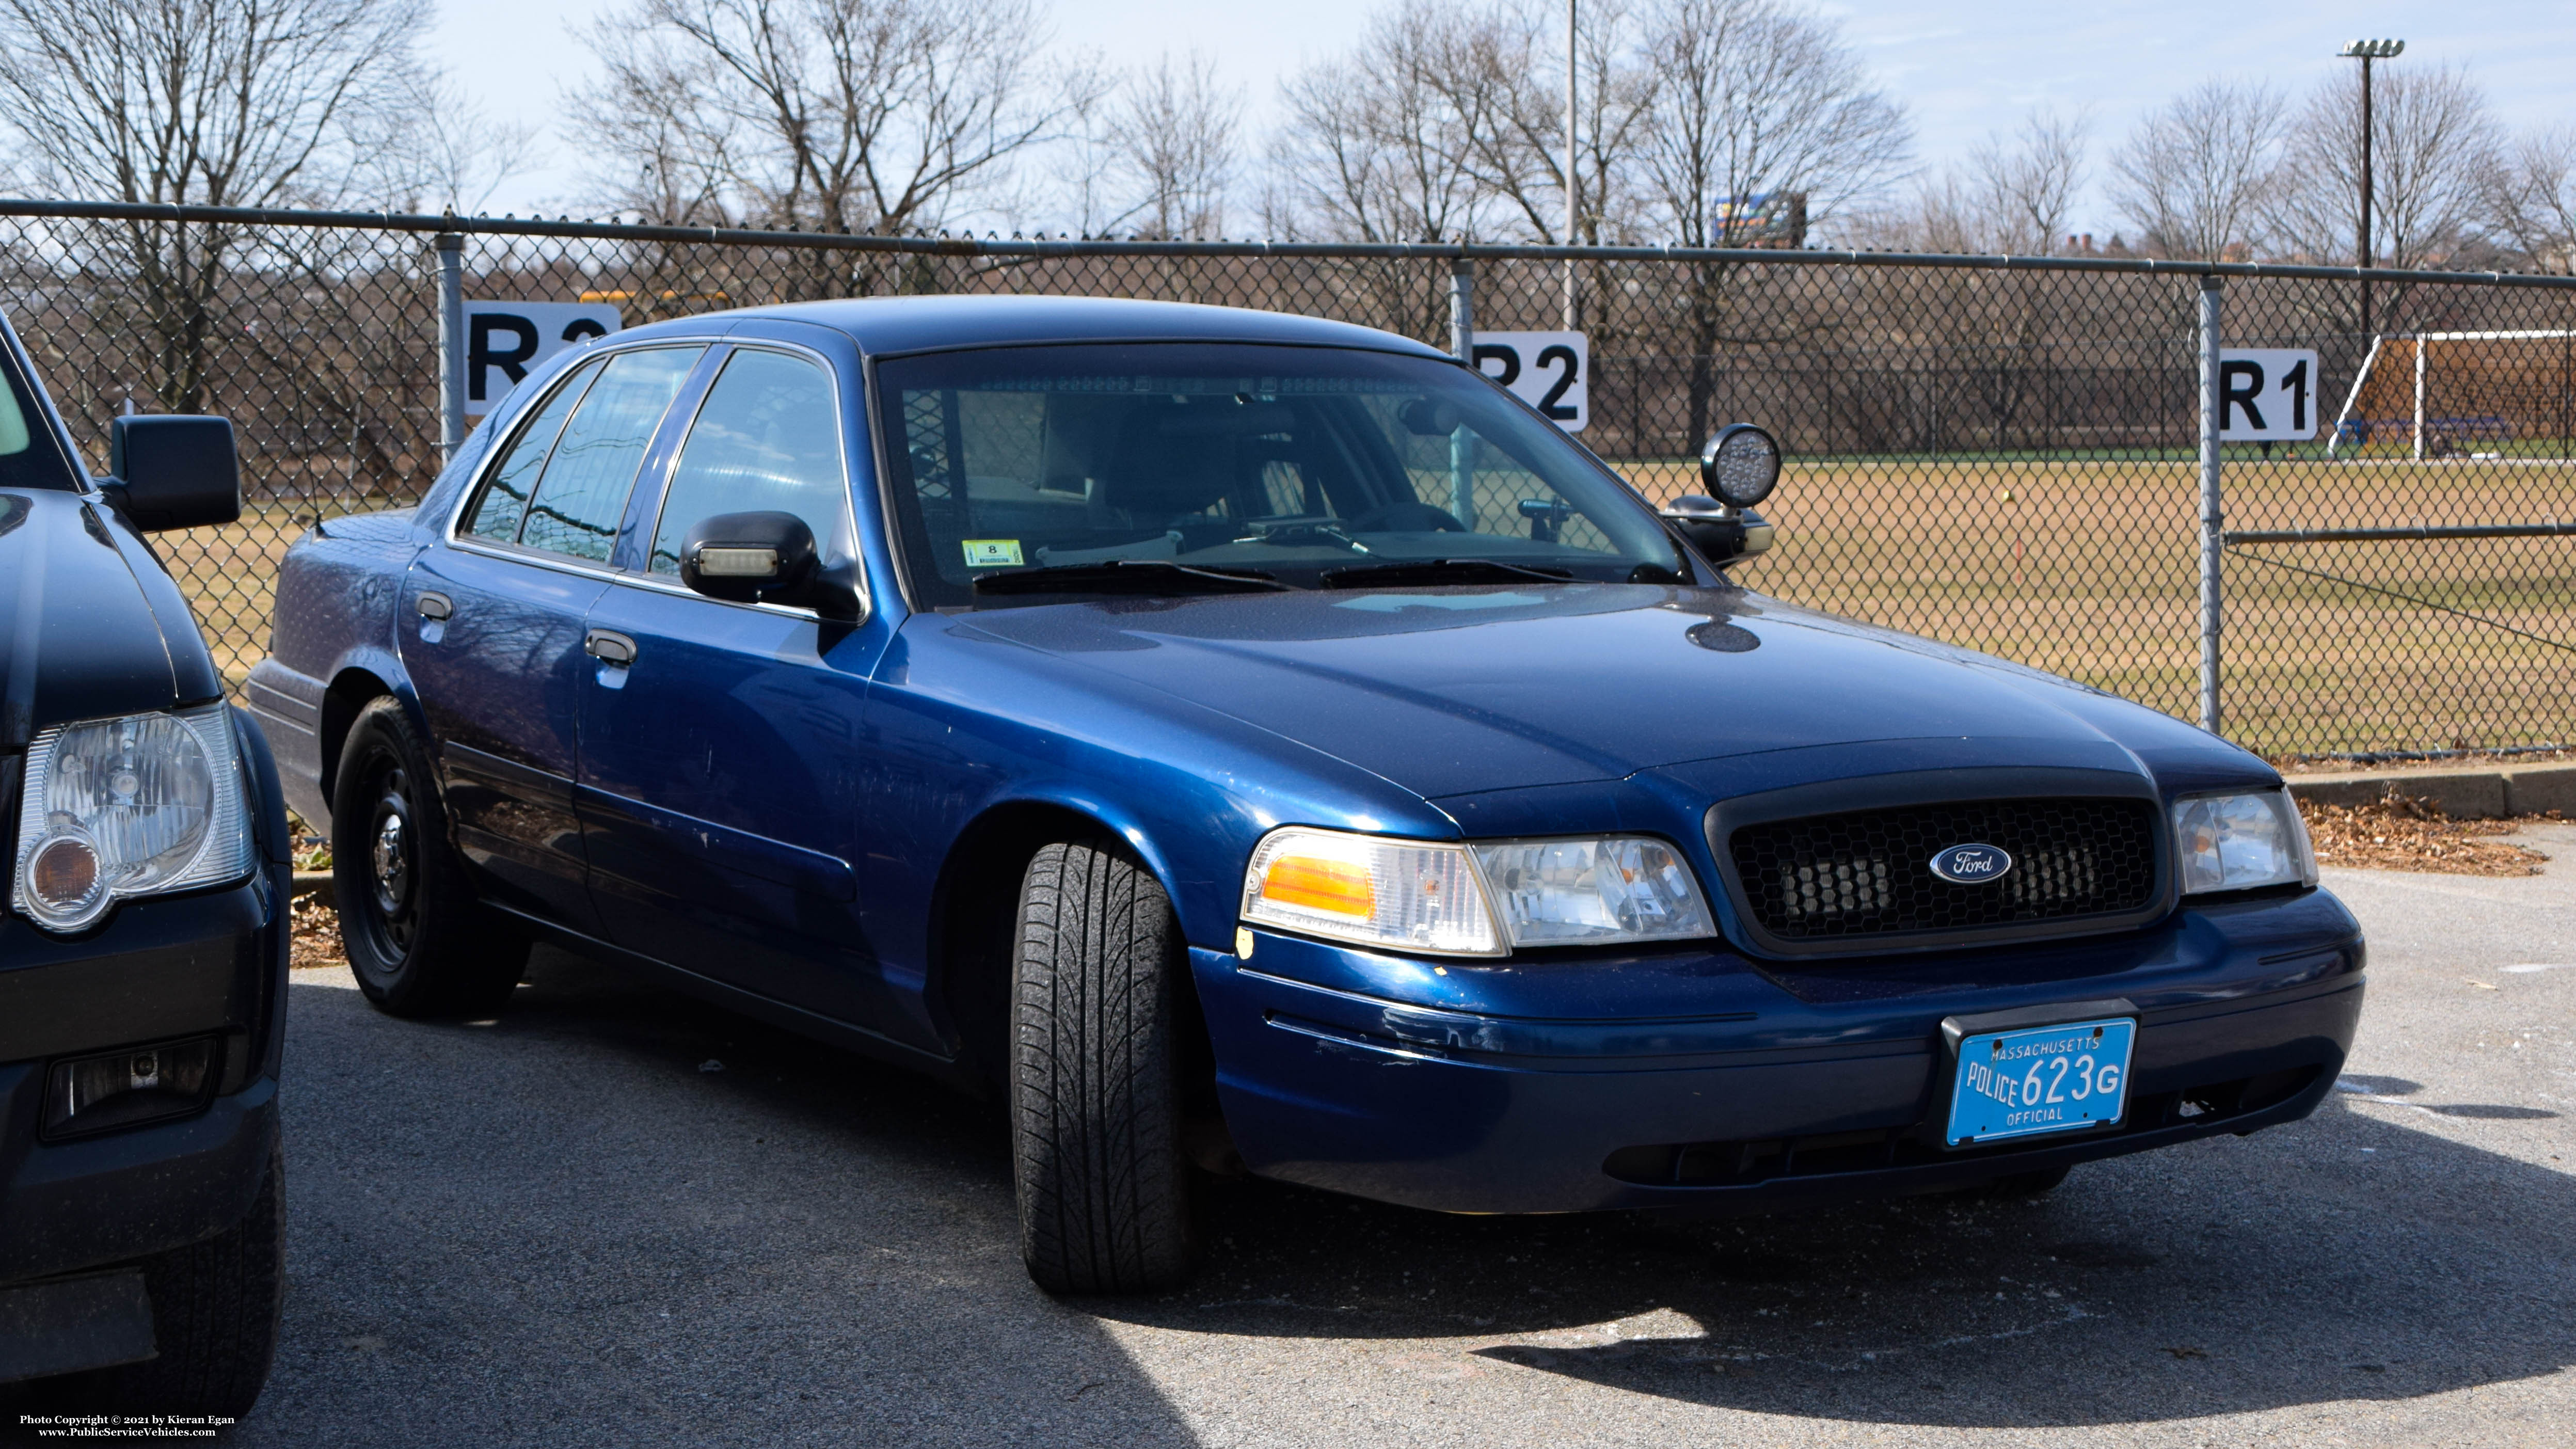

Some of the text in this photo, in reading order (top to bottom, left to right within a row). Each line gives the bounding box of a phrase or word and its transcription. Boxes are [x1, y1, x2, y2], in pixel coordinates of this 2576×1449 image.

[469, 313, 607, 400] R
[2220, 359, 2307, 430] R1
[1953, 851, 1993, 873] Ford
[1991, 1038, 2100, 1061] MASSACHUSETTS
[1966, 1061, 2018, 1107] POLICE
[2007, 1107, 2063, 1127] OFFICIAL
